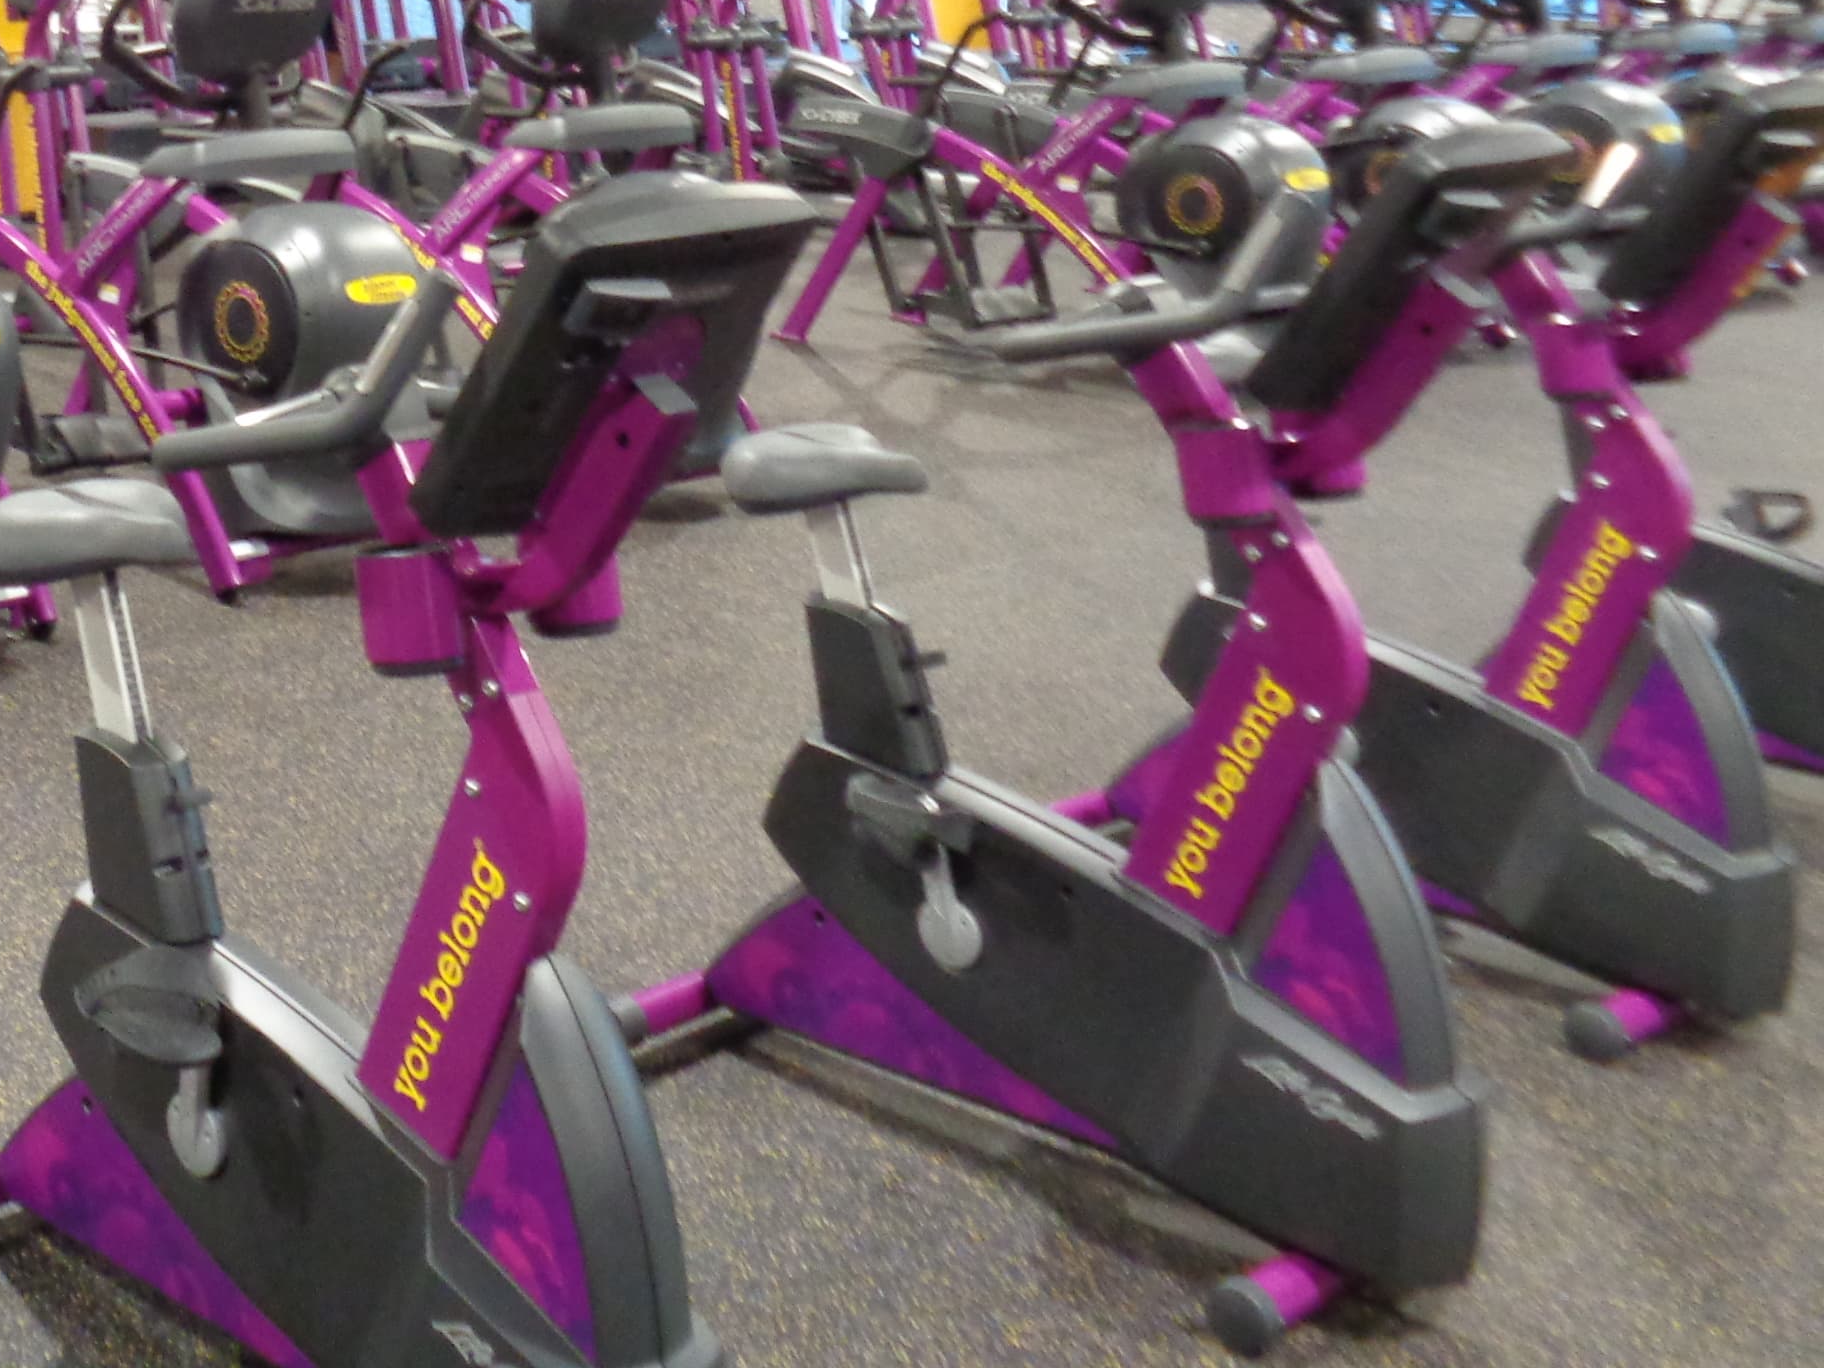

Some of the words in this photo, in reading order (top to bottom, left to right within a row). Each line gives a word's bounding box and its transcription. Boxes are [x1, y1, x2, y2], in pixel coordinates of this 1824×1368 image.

[1520, 645, 1567, 709] you
[1546, 520, 1633, 645] belong
[1165, 818, 1221, 898] you
[1198, 667, 1295, 820] belong
[393, 1018, 443, 1111] you
[421, 838, 507, 1020] belong
